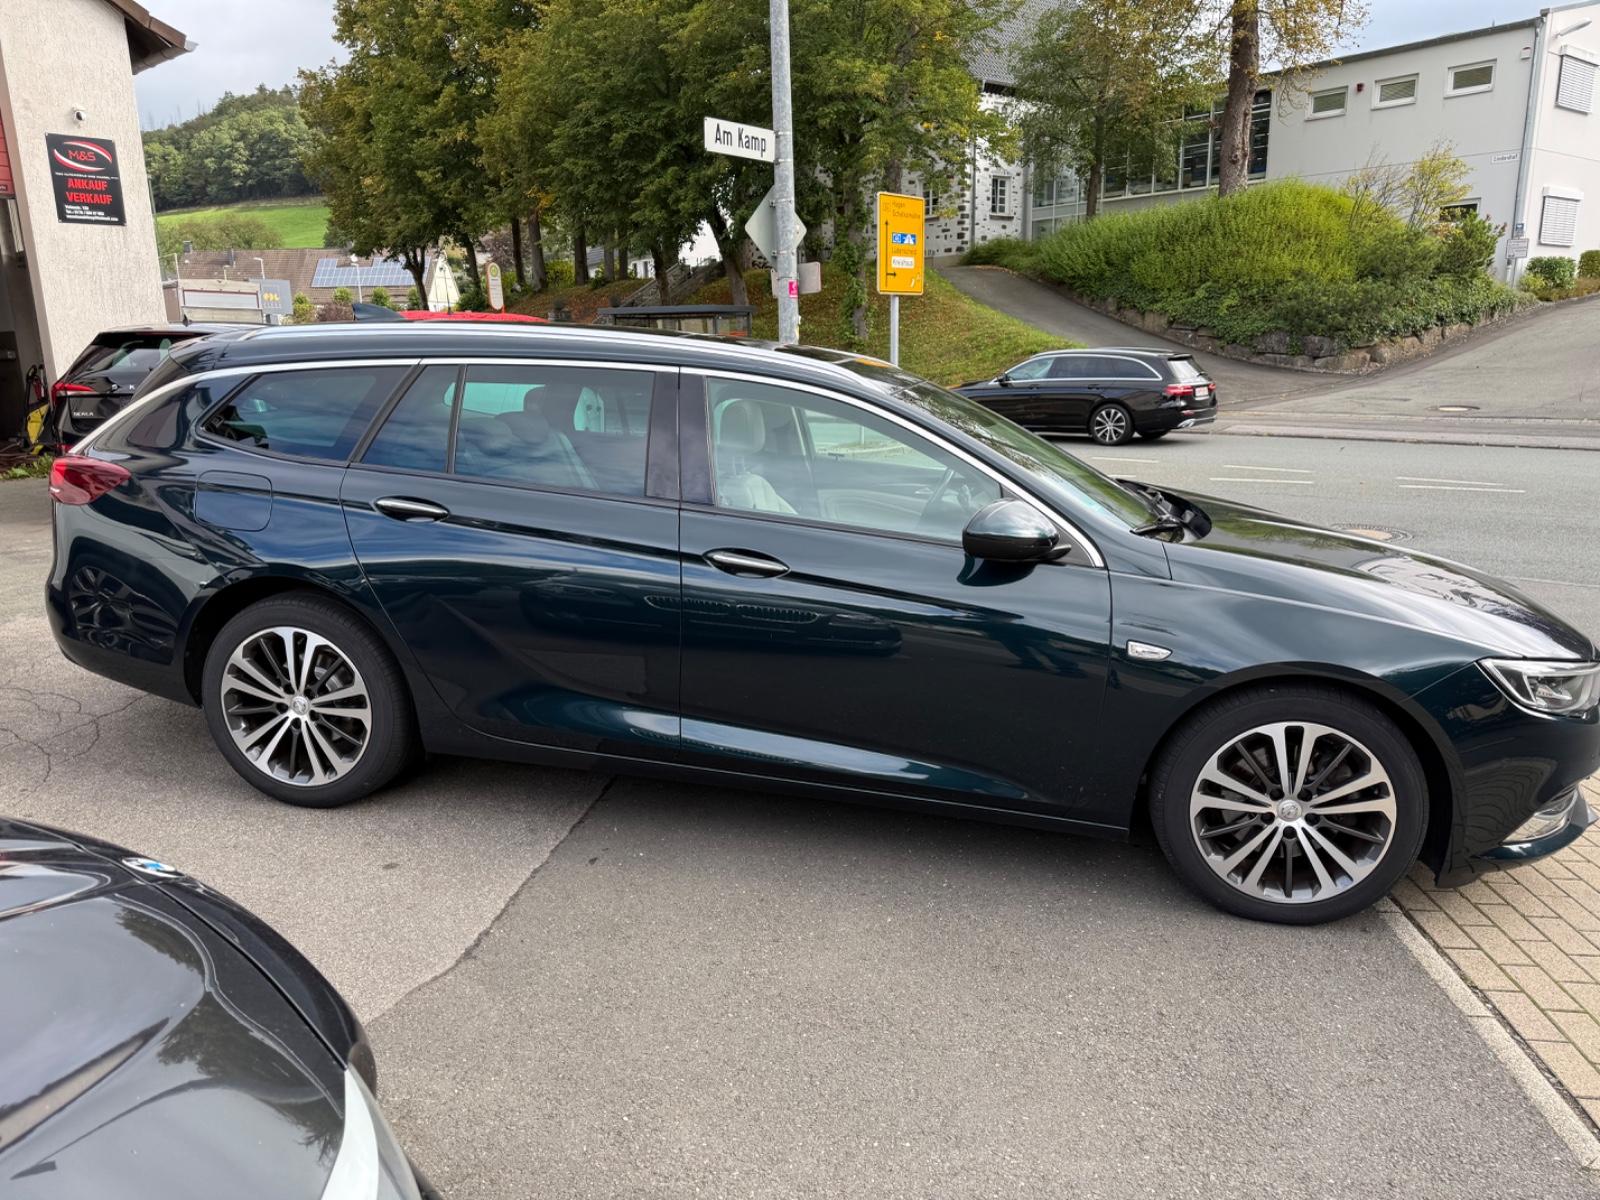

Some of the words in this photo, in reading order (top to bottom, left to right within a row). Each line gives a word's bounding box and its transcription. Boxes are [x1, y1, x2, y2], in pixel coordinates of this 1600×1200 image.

[715, 123, 733, 146] Am
[738, 127, 767, 158] Kamp
[68, 150, 97, 161] M&S
[67, 178, 108, 190] ANKAUF
[65, 191, 112, 204] VERKAUF
